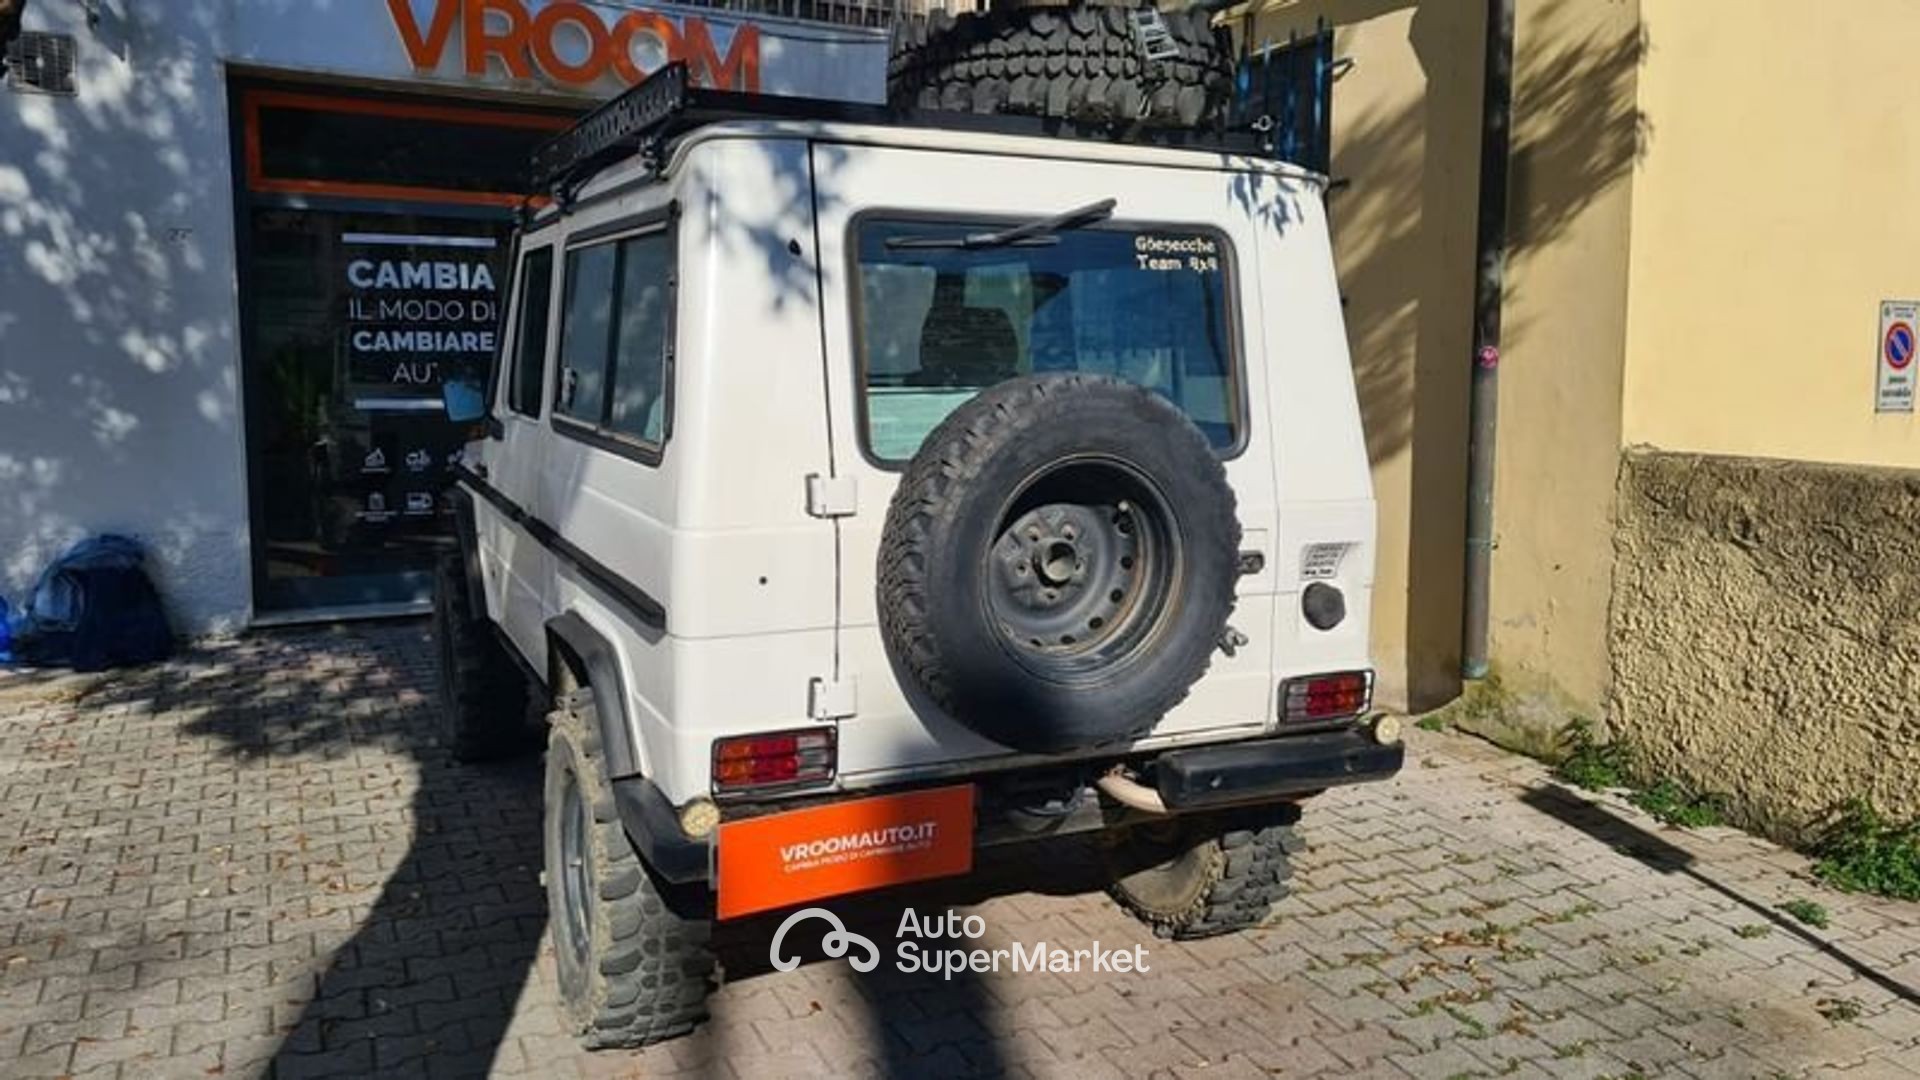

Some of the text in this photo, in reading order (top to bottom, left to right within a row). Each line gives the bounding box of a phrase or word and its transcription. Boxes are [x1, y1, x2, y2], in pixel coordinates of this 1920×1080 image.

[384, 0, 760, 94] VROOM
[348, 259, 495, 290] CAMBIA
[1136, 254, 1182, 270] Team
[350, 298, 496, 321] IL MODO DI
[353, 331, 495, 351] CAMBIARE
[780, 822, 937, 862] VROOMAUTO.IT
